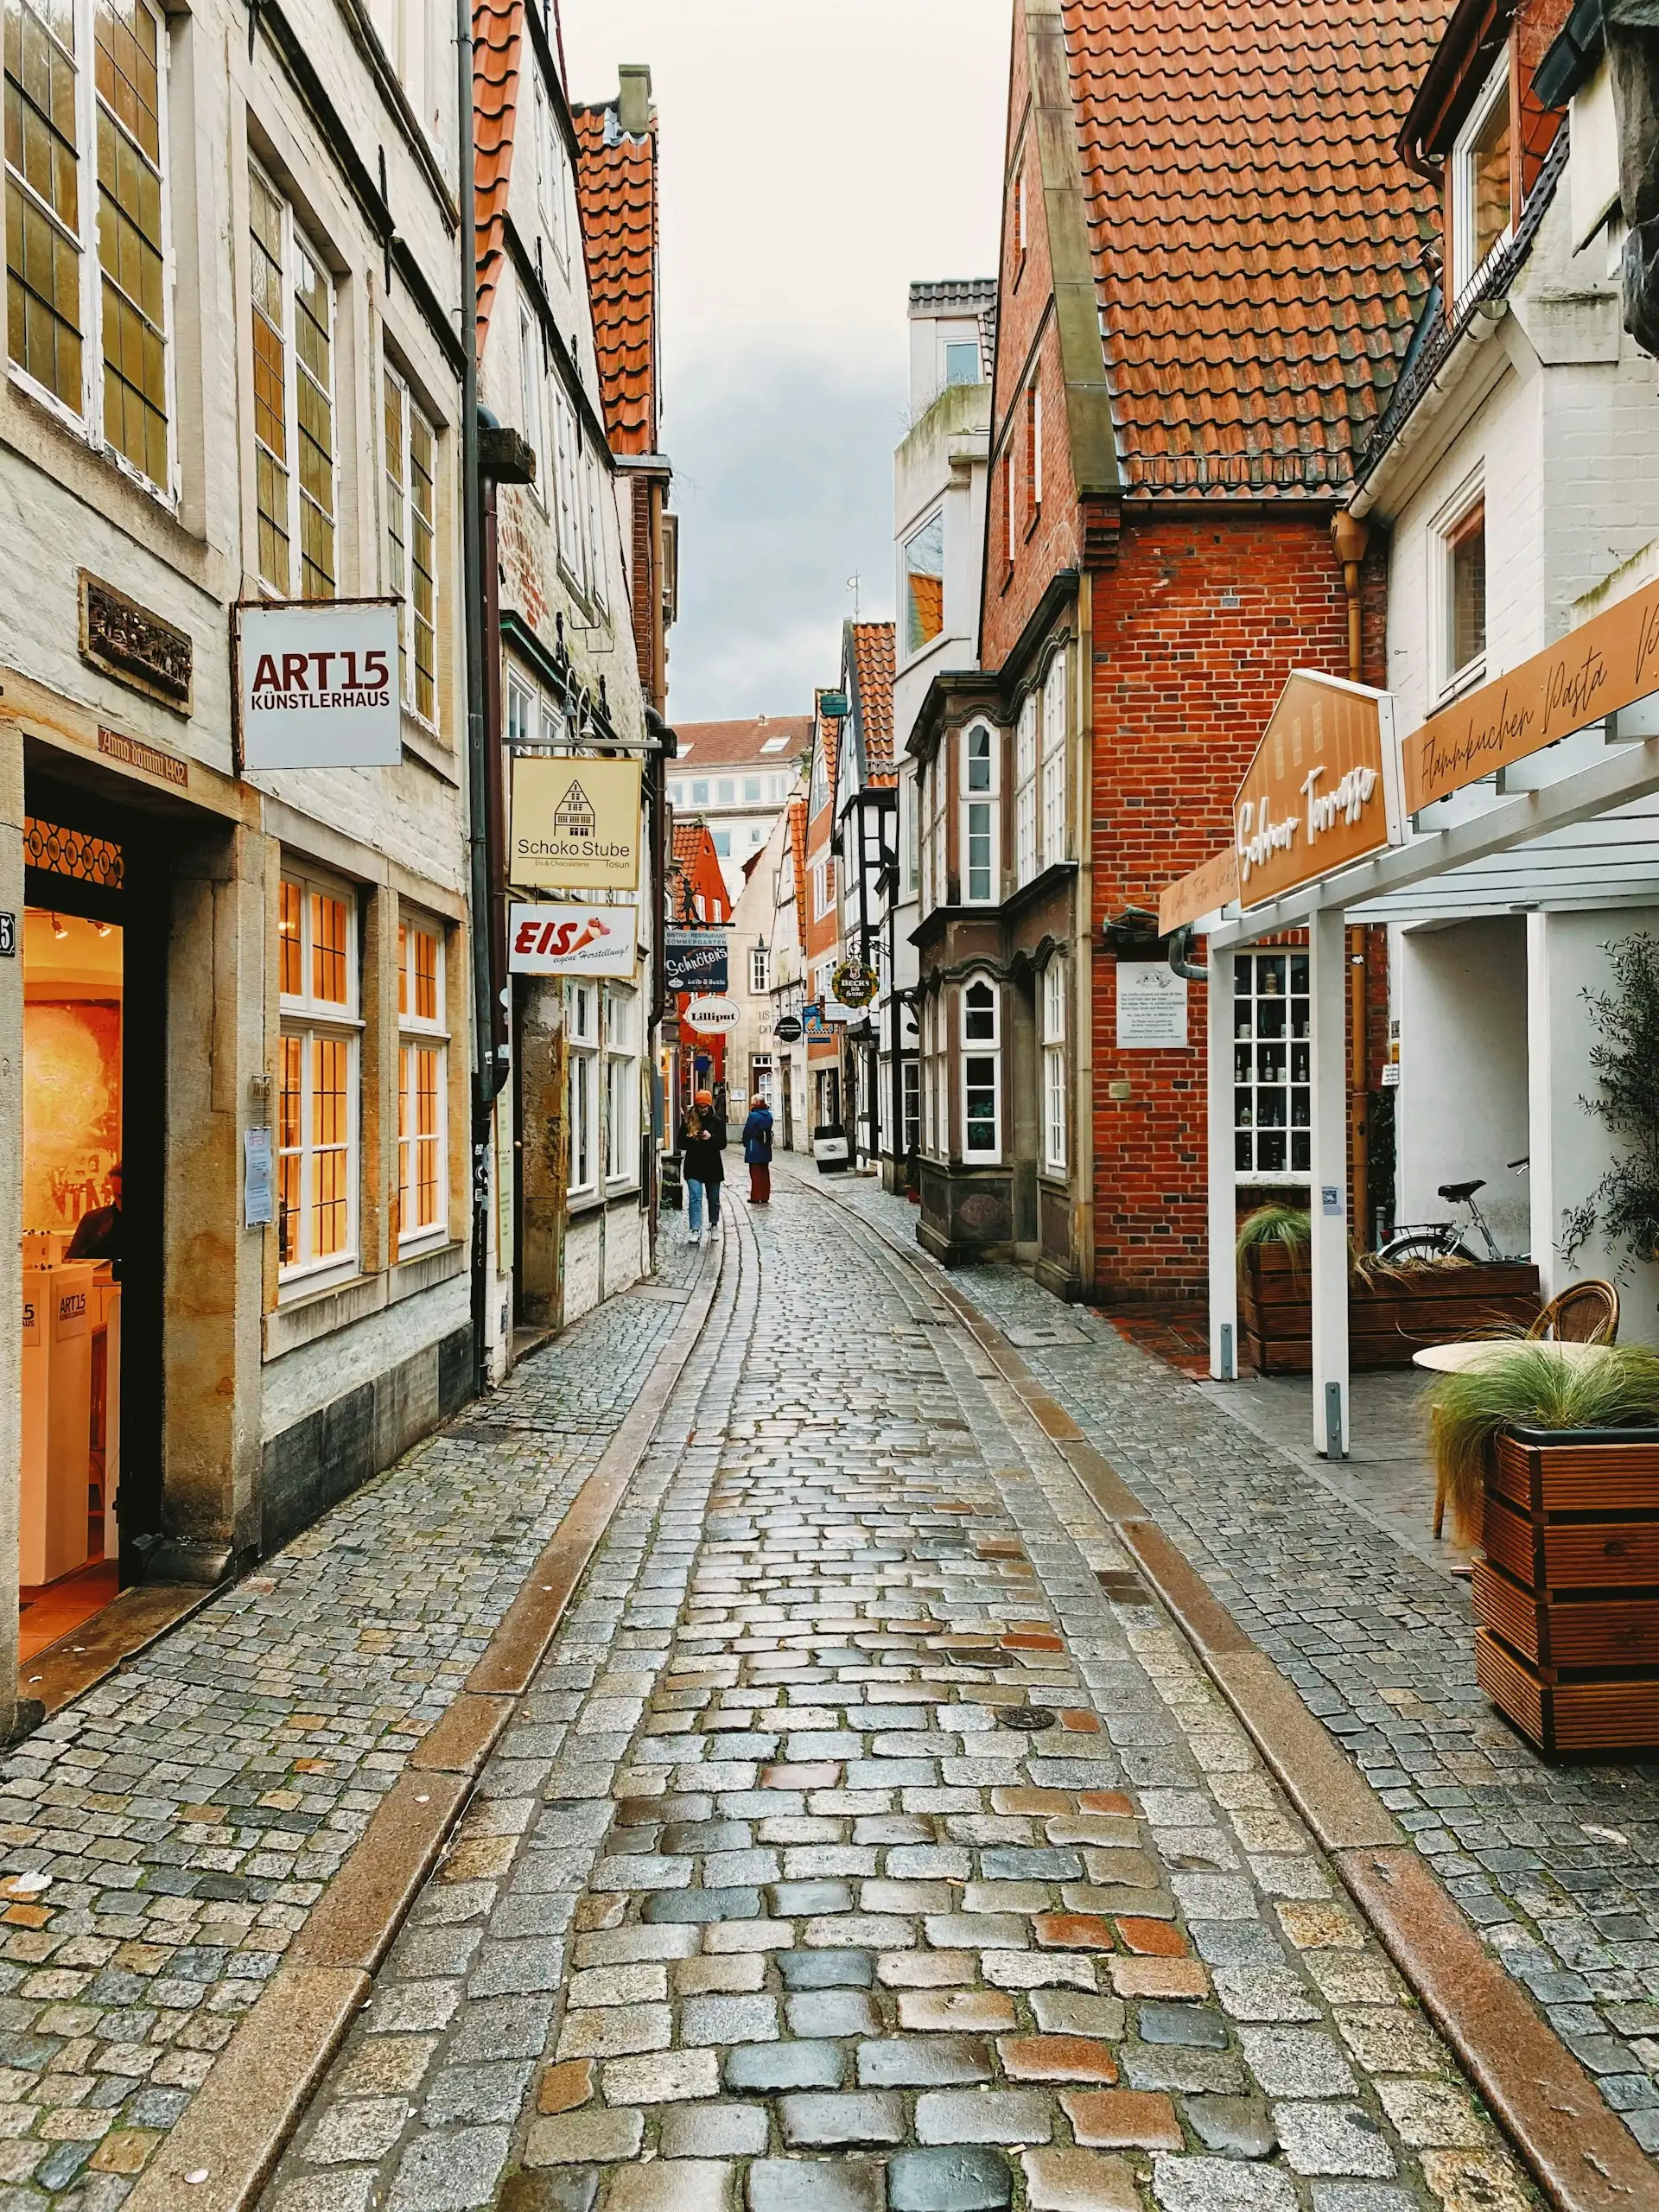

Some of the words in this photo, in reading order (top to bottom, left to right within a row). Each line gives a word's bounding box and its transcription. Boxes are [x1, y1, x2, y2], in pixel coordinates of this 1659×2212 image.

[251, 690, 390, 710] KÜNSTLERHAUS
[1421, 688, 1535, 795] Flammkuchen
[1541, 645, 1608, 734] Pasta
[99, 728, 130, 762] Anno
[130, 741, 164, 777] domini
[518, 839, 579, 855] Schoko
[582, 842, 630, 857] Stube
[550, 860, 590, 868] Chocolaterie
[605, 860, 630, 869] Tosun
[0, 918, 10, 949] 5
[514, 922, 578, 956] EIS
[553, 955, 576, 964] eigene
[577, 945, 629, 960] Herstellung!
[691, 1013, 735, 1023] Lilliput
